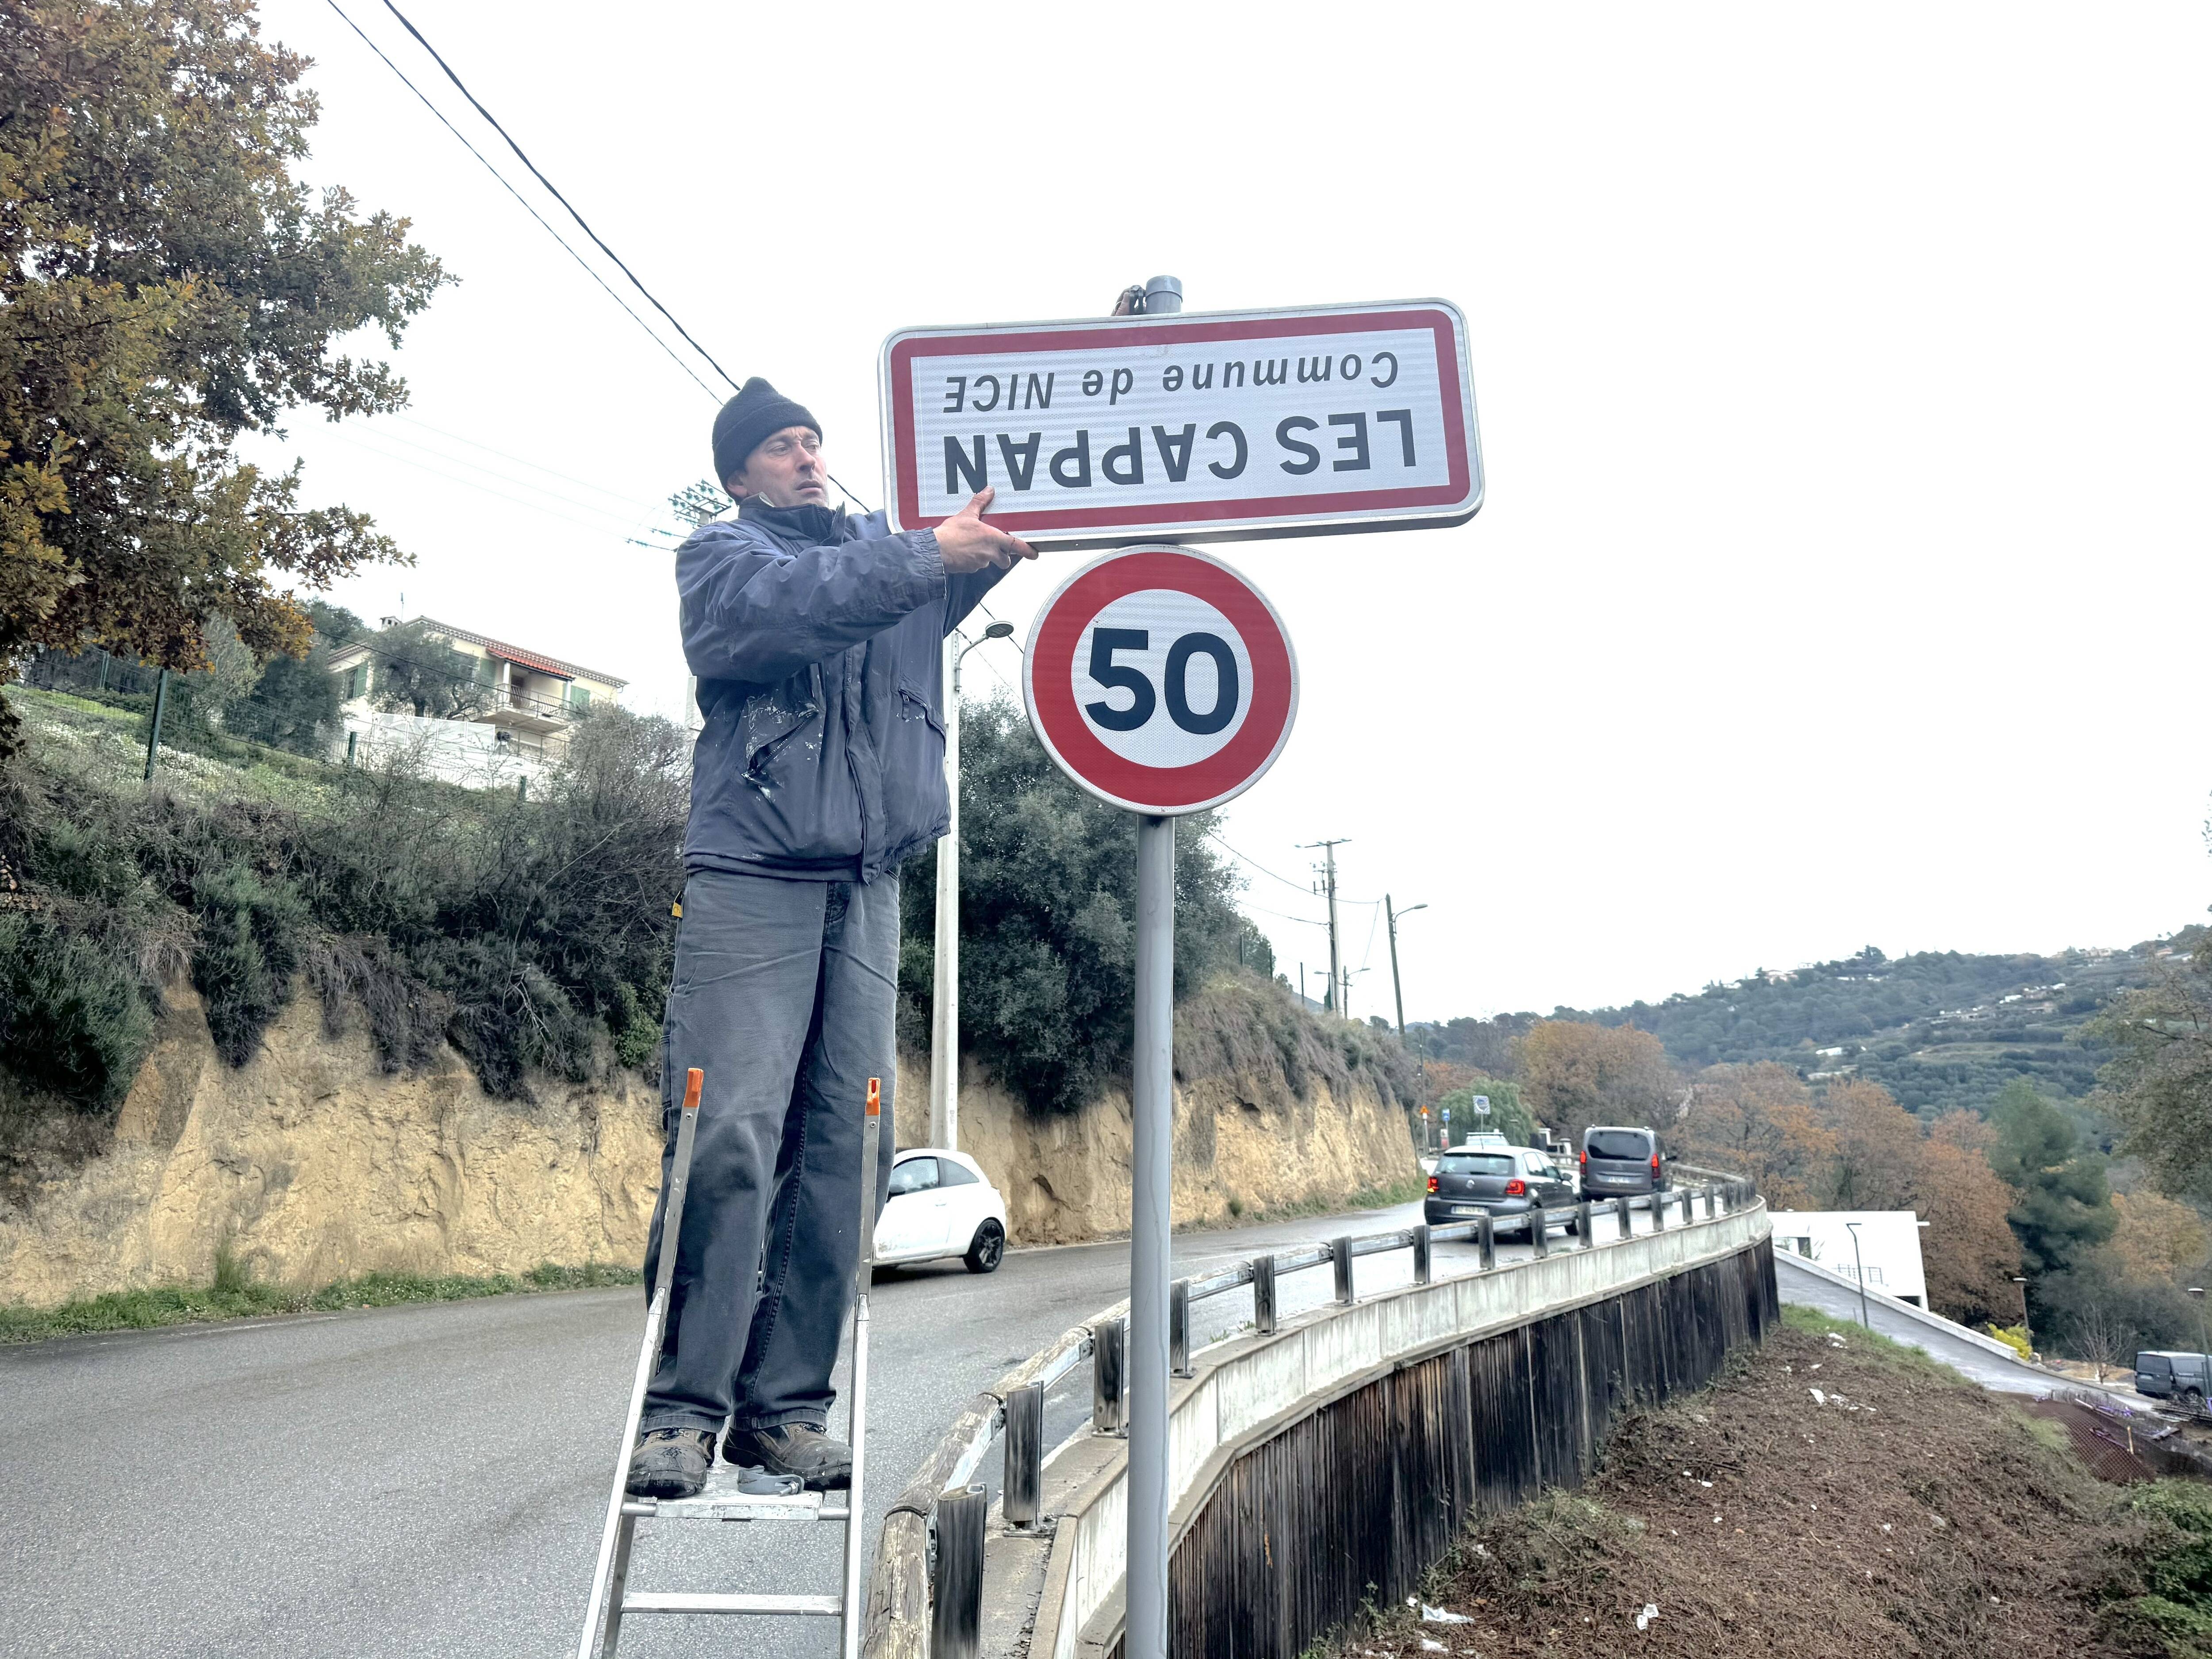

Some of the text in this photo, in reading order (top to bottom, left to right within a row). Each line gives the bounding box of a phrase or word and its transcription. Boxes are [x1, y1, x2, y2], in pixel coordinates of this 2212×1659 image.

[943, 351, 1399, 414] Commune de NICE
[943, 408, 1417, 495] LES CAPPAN
[1084, 627, 1240, 735] 50
